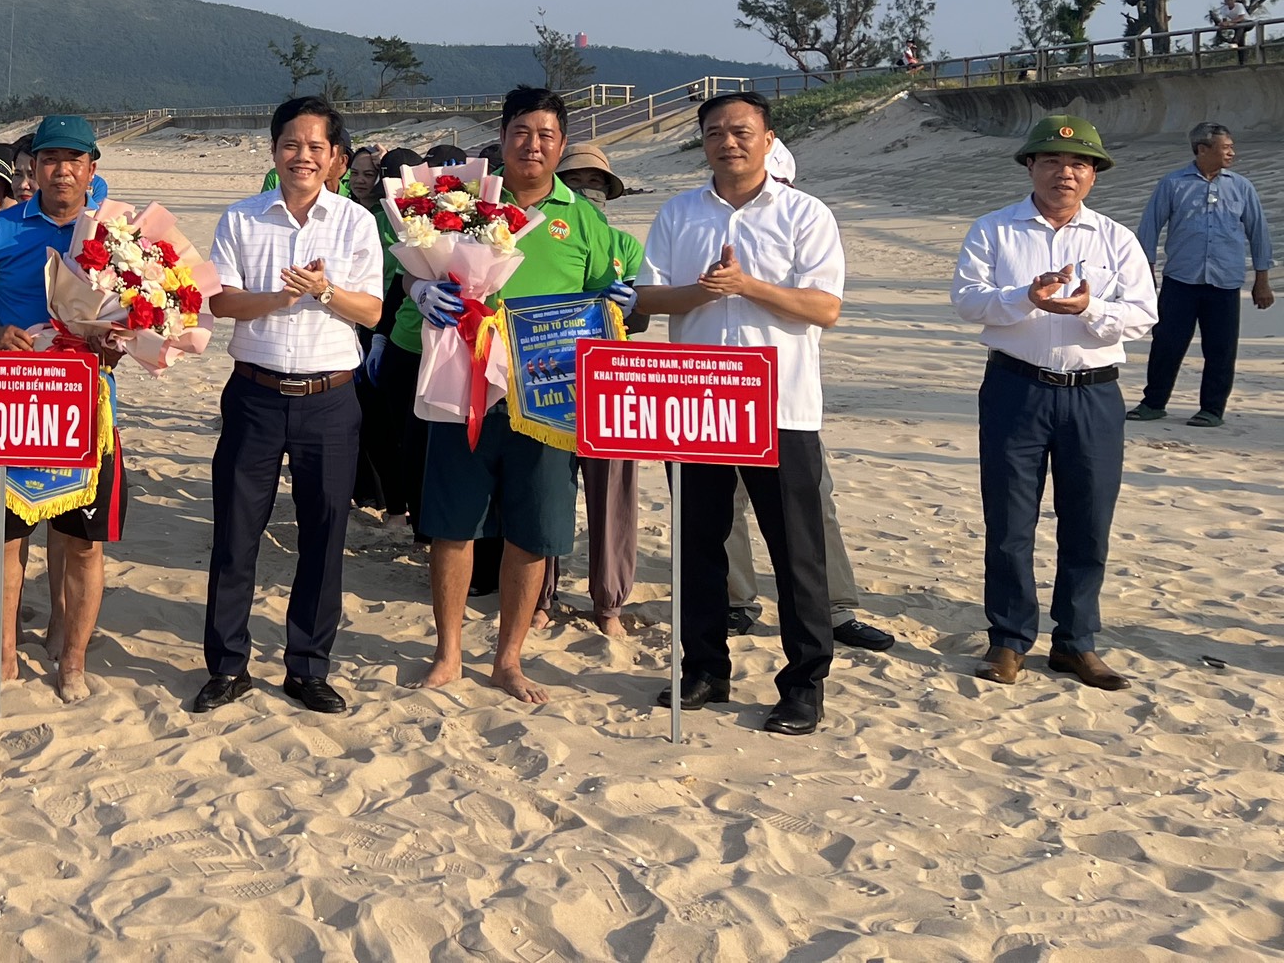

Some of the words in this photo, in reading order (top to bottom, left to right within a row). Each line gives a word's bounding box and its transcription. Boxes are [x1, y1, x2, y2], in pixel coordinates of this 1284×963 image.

[532, 323, 550, 334] BAN
[564, 318, 586, 328] CHỨC
[612, 354, 628, 367] GIẢI
[630, 356, 646, 368] KÉO
[647, 358, 658, 368] CO
[660, 359, 681, 370] NAM,
[696, 358, 717, 370] CHÀO
[719, 359, 743, 371] MỪNG
[22, 365, 42, 377] CHÀO
[44, 366, 66, 377] MỪNG
[594, 370, 613, 381] KHAI
[648, 371, 666, 383] MÙA
[668, 374, 678, 384] DU
[680, 374, 698, 386] LỊCH
[741, 376, 761, 386] 2026
[8, 381, 24, 392] LỊCH
[64, 383, 82, 392] 2026
[533, 388, 564, 408] Lưu
[598, 385, 658, 439] LIÊN
[665, 389, 737, 446] QUÂN
[744, 400, 756, 444] 1
[66, 405, 80, 447] 2
